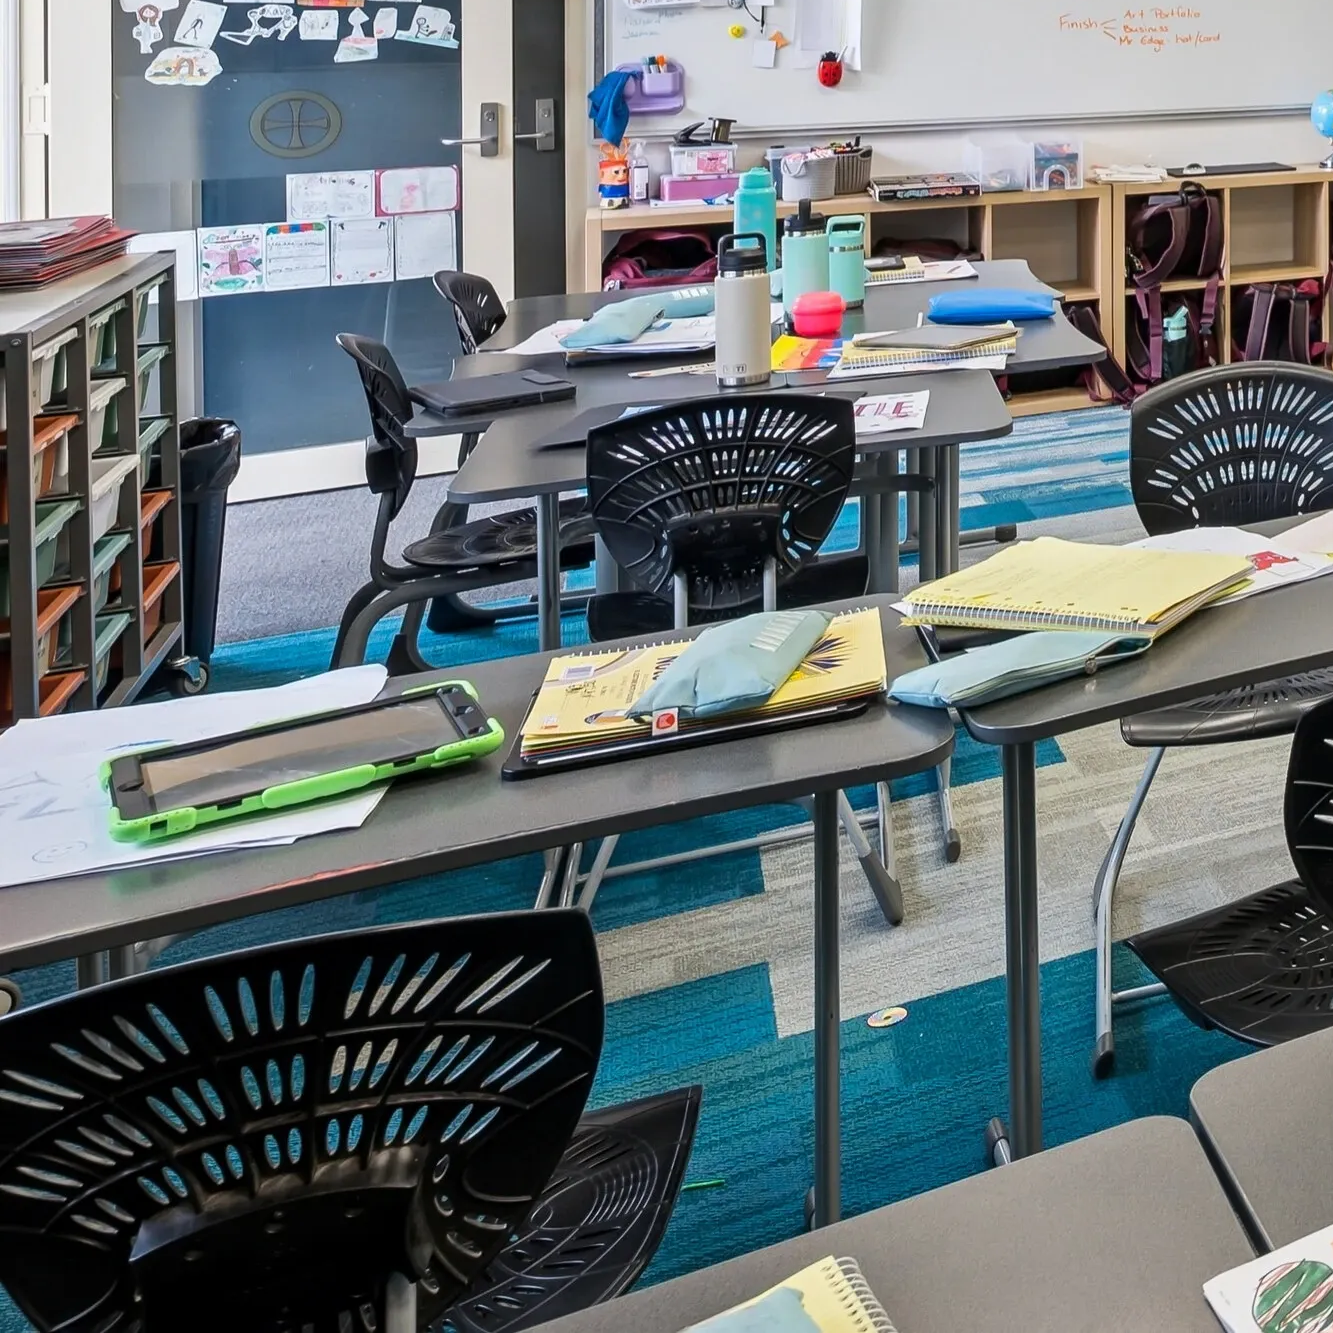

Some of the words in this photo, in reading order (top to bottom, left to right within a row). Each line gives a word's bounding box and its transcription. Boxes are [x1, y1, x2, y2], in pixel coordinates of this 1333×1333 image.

[1123, 9, 1145, 19] Art
[1150, 6, 1201, 19] Portfolio
[1059, 14, 1098, 31] Finish
[1123, 25, 1169, 34] Business
[723, 364, 746, 373] TI
